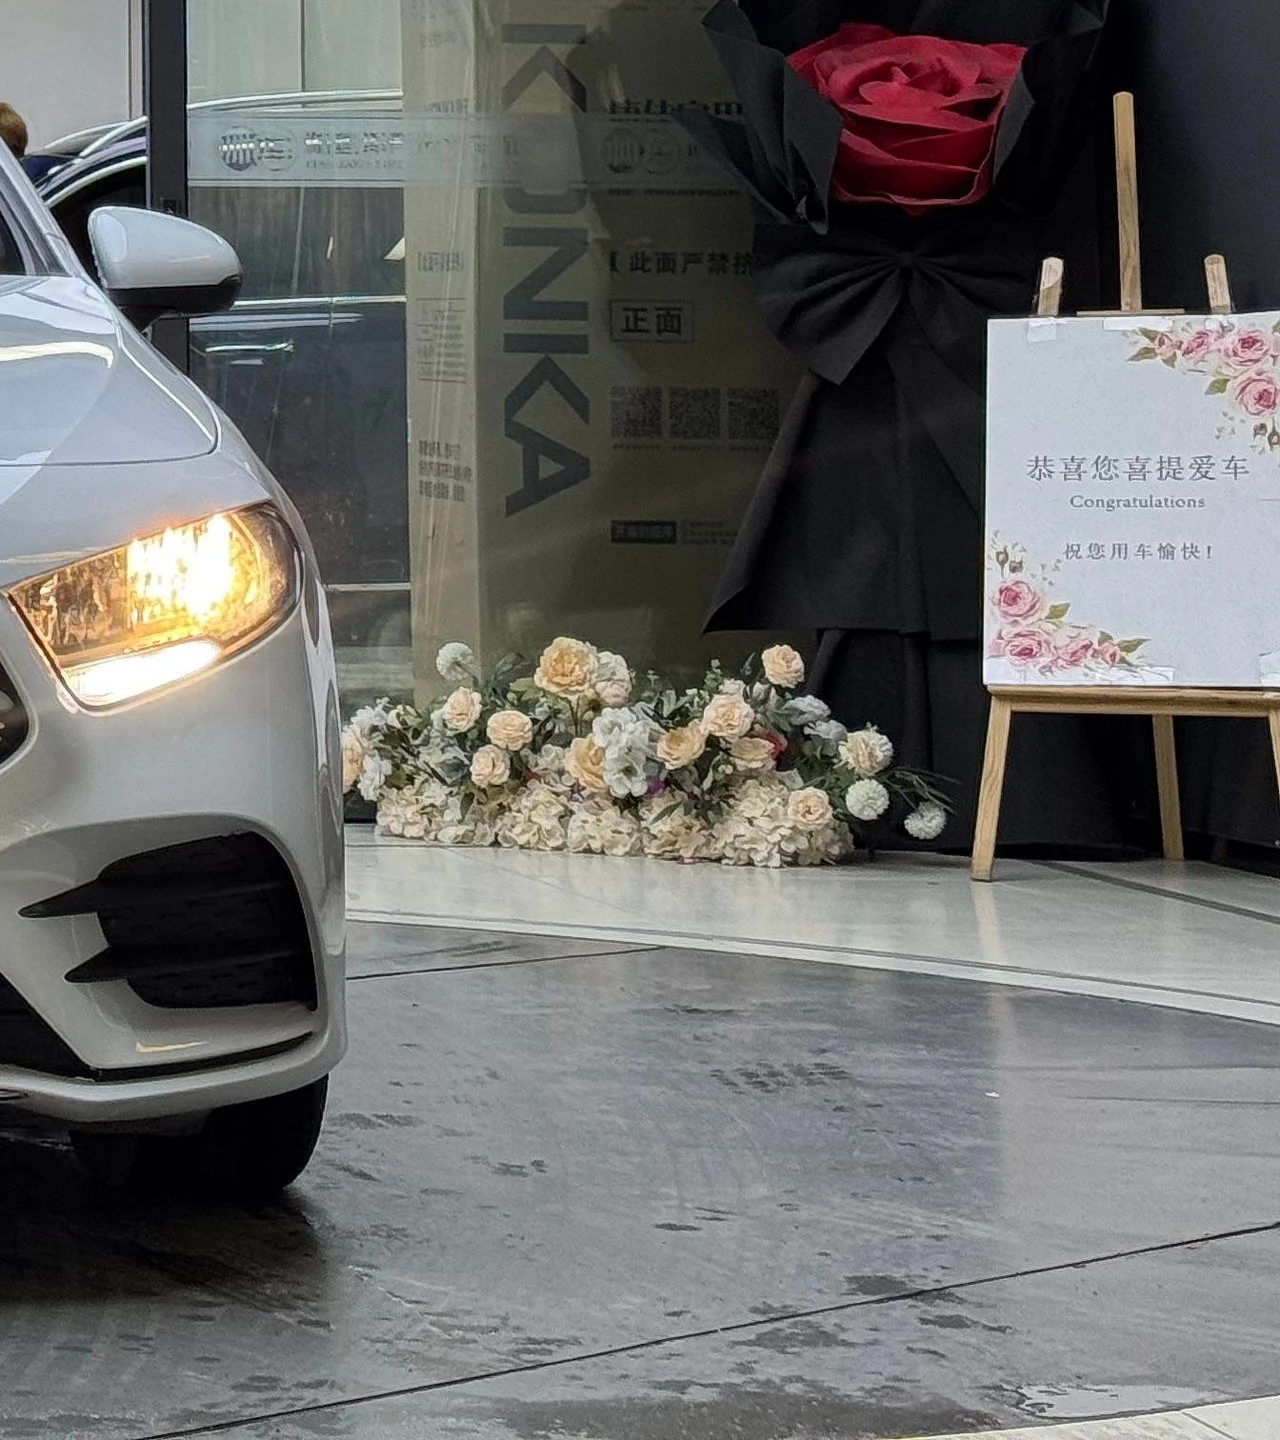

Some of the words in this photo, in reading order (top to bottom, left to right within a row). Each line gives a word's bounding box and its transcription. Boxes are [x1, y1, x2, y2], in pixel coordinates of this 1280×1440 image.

[619, 306, 684, 336] 正面
[1026, 454, 1251, 482] 恭喜您喜提爱车
[1069, 493, 1206, 512] Congratulations
